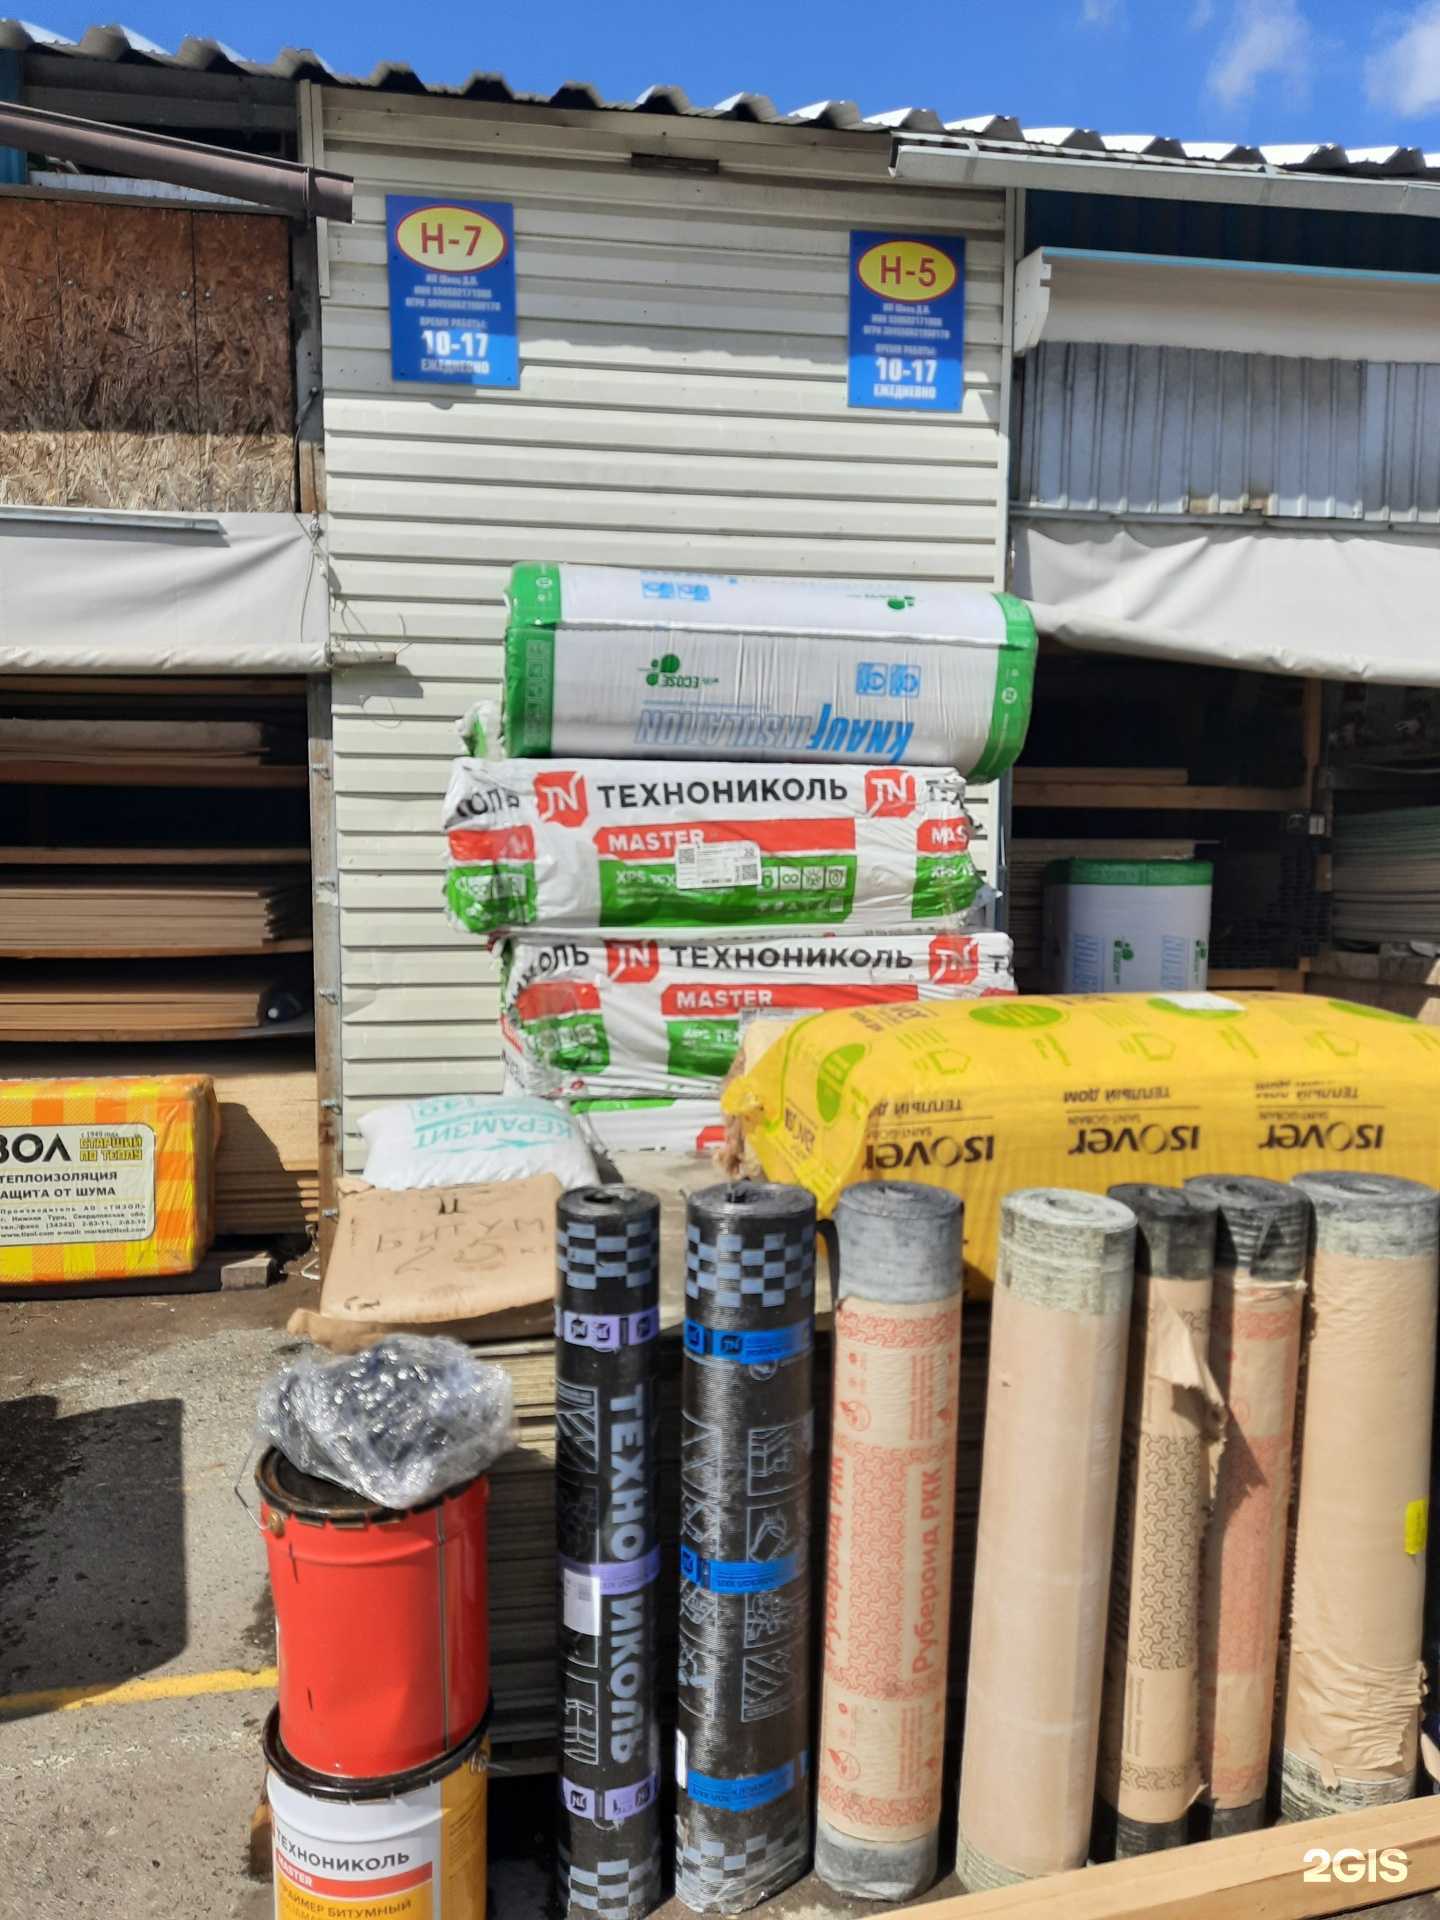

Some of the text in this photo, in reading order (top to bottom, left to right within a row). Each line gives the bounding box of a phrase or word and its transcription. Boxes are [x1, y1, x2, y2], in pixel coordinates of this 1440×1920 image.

[421, 222, 482, 256] Н-7
[881, 255, 937, 287] Н-5
[421, 329, 490, 358] 10-17
[421, 358, 491, 375] ЕЖЕДНЕВНО
[875, 357, 938, 383] 10-17
[873, 384, 937, 400] ЕЖЕДНЕВНО
[662, 675, 700, 688] ECOSE
[634, 708, 814, 749] INSULATION
[597, 777, 849, 809] ТЕХНОНИКОЛЬ
[608, 829, 705, 852] MASTER
[670, 945, 913, 970] ТЕХНОНИКОЛЬ
[677, 990, 773, 1010] MASTER
[1105, 1087, 1170, 1102] ТЕПЛЫЙ
[80, 1133, 143, 1149] СТАРШИЙ
[414, 1115, 577, 1149] КЕРАМЗИТ
[54, 1188, 71, 1198] ОТ
[76, 1187, 116, 1197] ШУМА
[920, 1466, 943, 1521] РКК
[610, 1383, 645, 1764] ТЕХНОИКОЛЬ
[911, 1525, 940, 1675] Рубероид
[276, 1829, 410, 1873] ТЕХНОНИКОЛЬ
[328, 1899, 412, 1919] БИТУМНЫЙ
